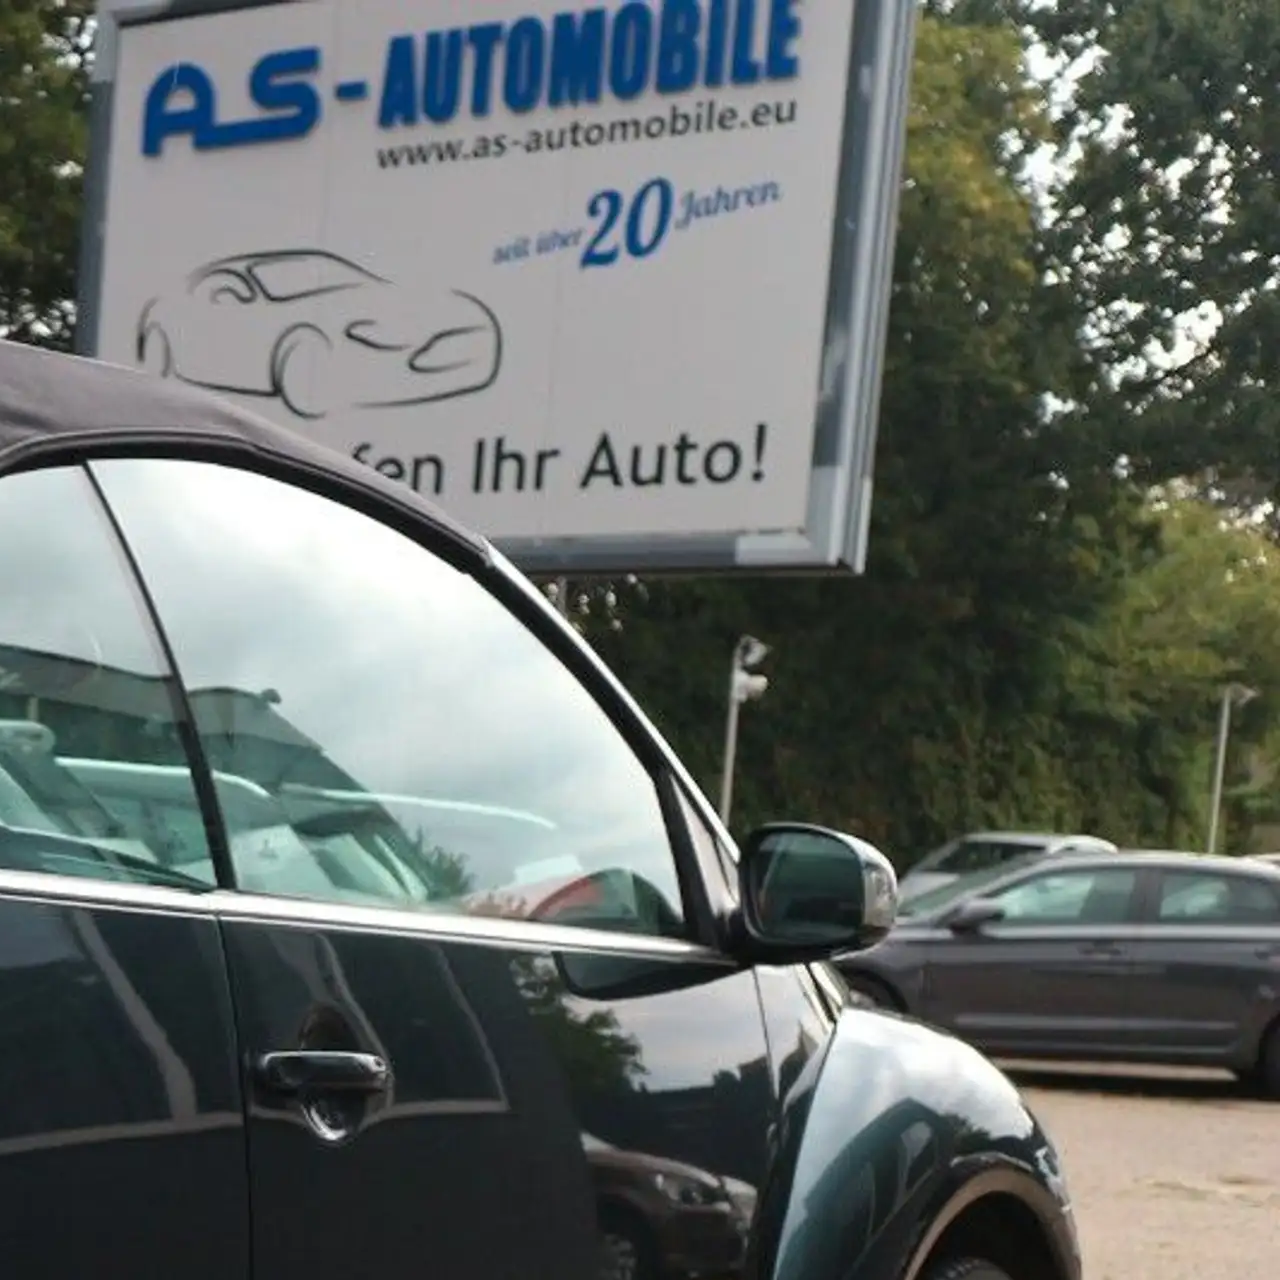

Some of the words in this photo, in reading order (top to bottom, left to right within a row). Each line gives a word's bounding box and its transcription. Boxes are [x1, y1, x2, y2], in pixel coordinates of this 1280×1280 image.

[376, 97, 798, 170] www.as-automobile.eu
[492, 239, 531, 264] seit
[579, 177, 674, 269] 20
[675, 178, 781, 230] Jahren
[473, 436, 560, 494] Ihr
[579, 424, 768, 490] Auto!
